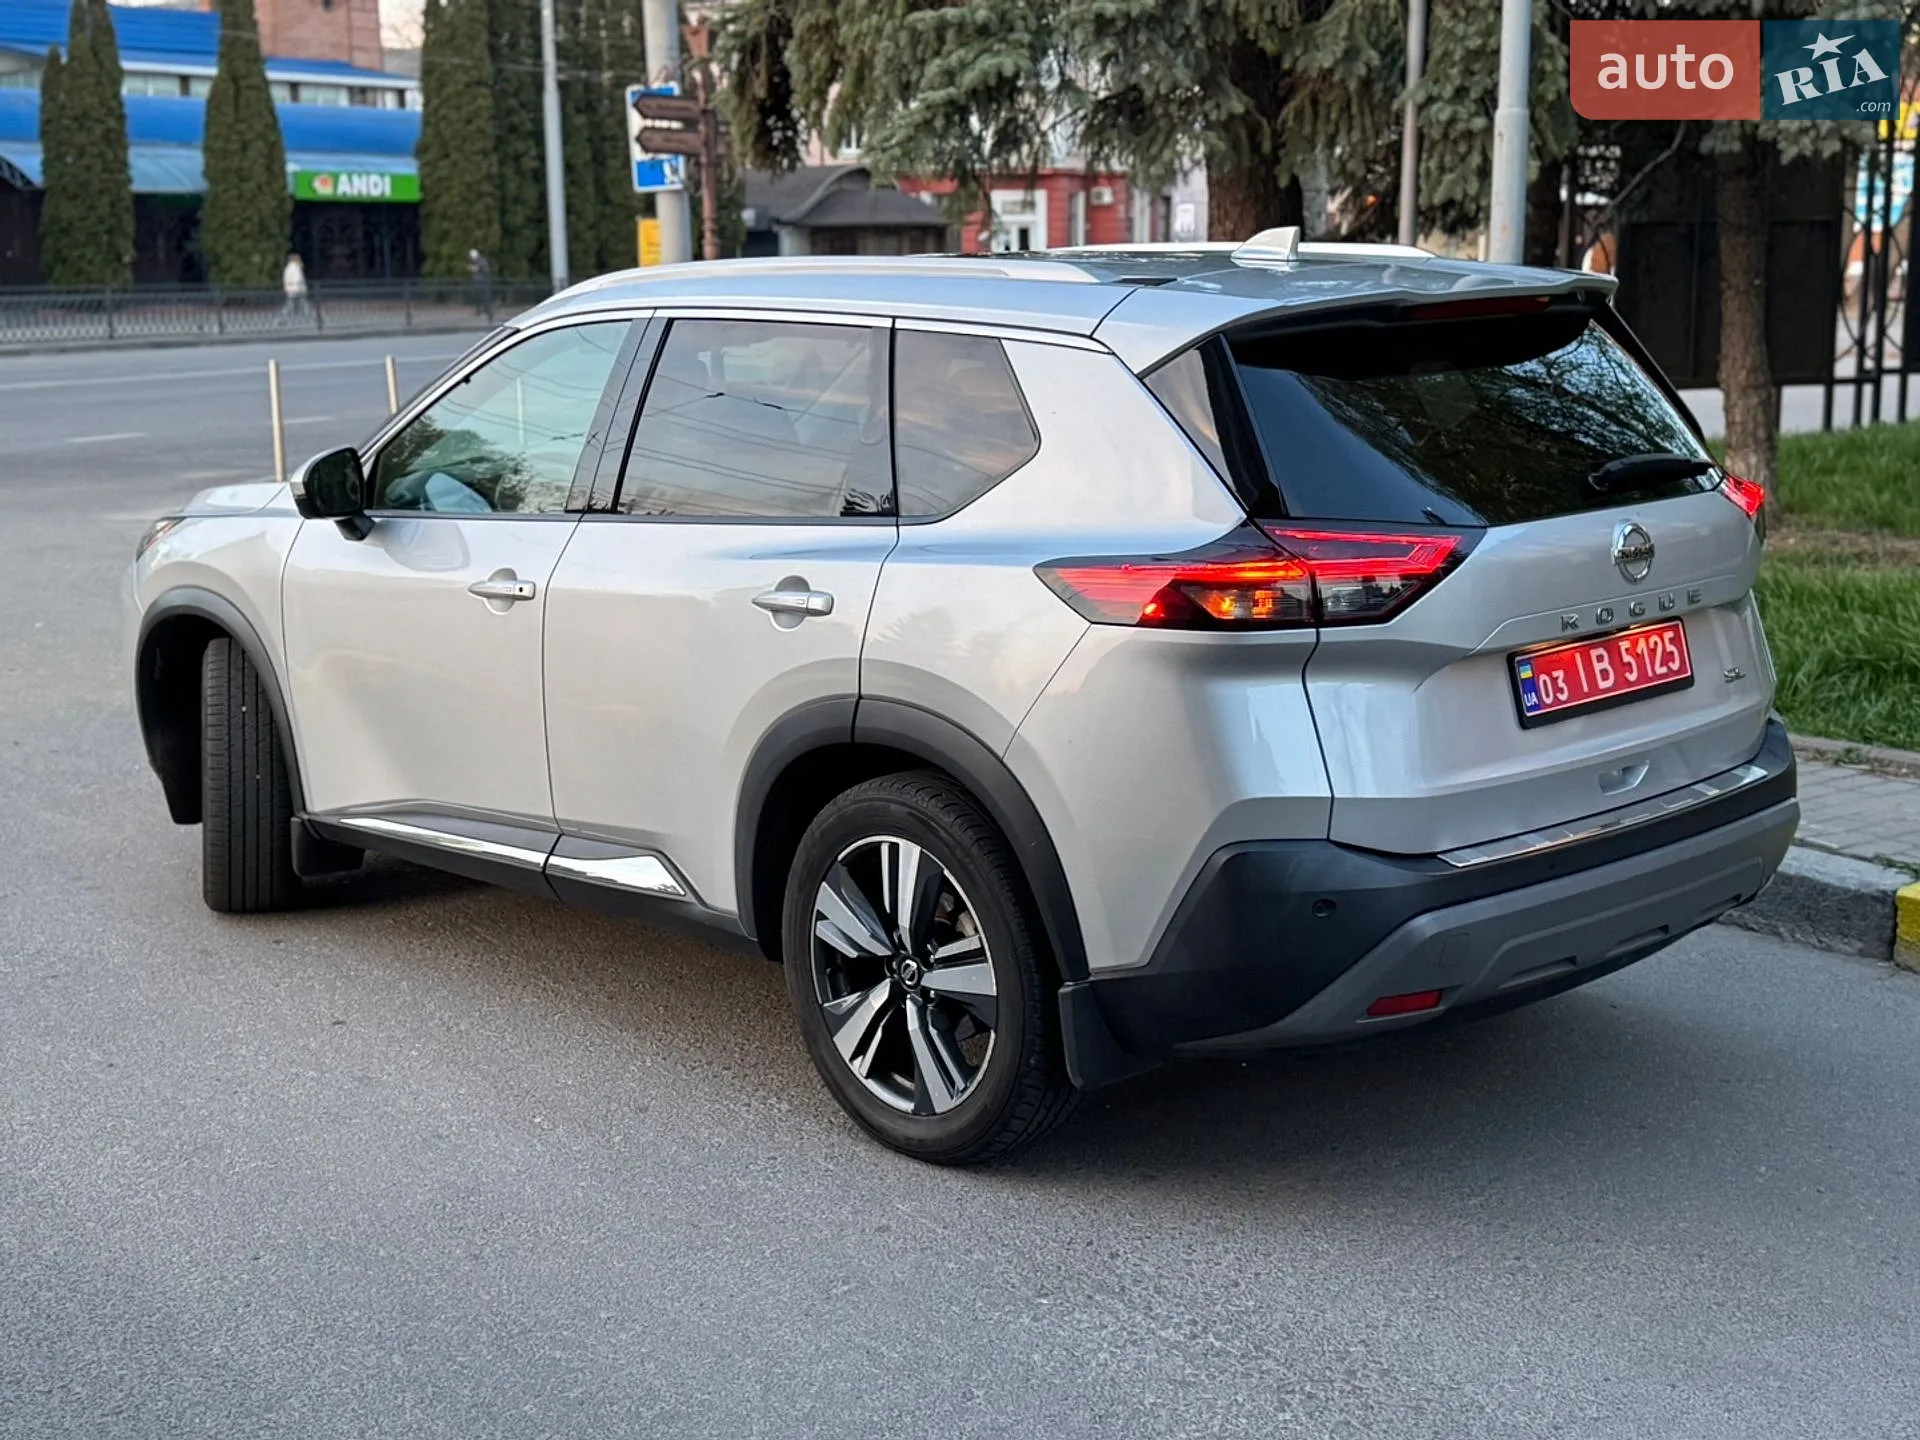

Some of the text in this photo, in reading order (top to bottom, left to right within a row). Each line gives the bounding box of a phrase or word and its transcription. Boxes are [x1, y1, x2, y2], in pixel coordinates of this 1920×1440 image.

[337, 173, 391, 197] ANDI
[1561, 589, 1702, 632] ROGUE
[1538, 669, 1568, 704] 03
[1619, 630, 1681, 682] 5125
[1524, 693, 1539, 707] UA
